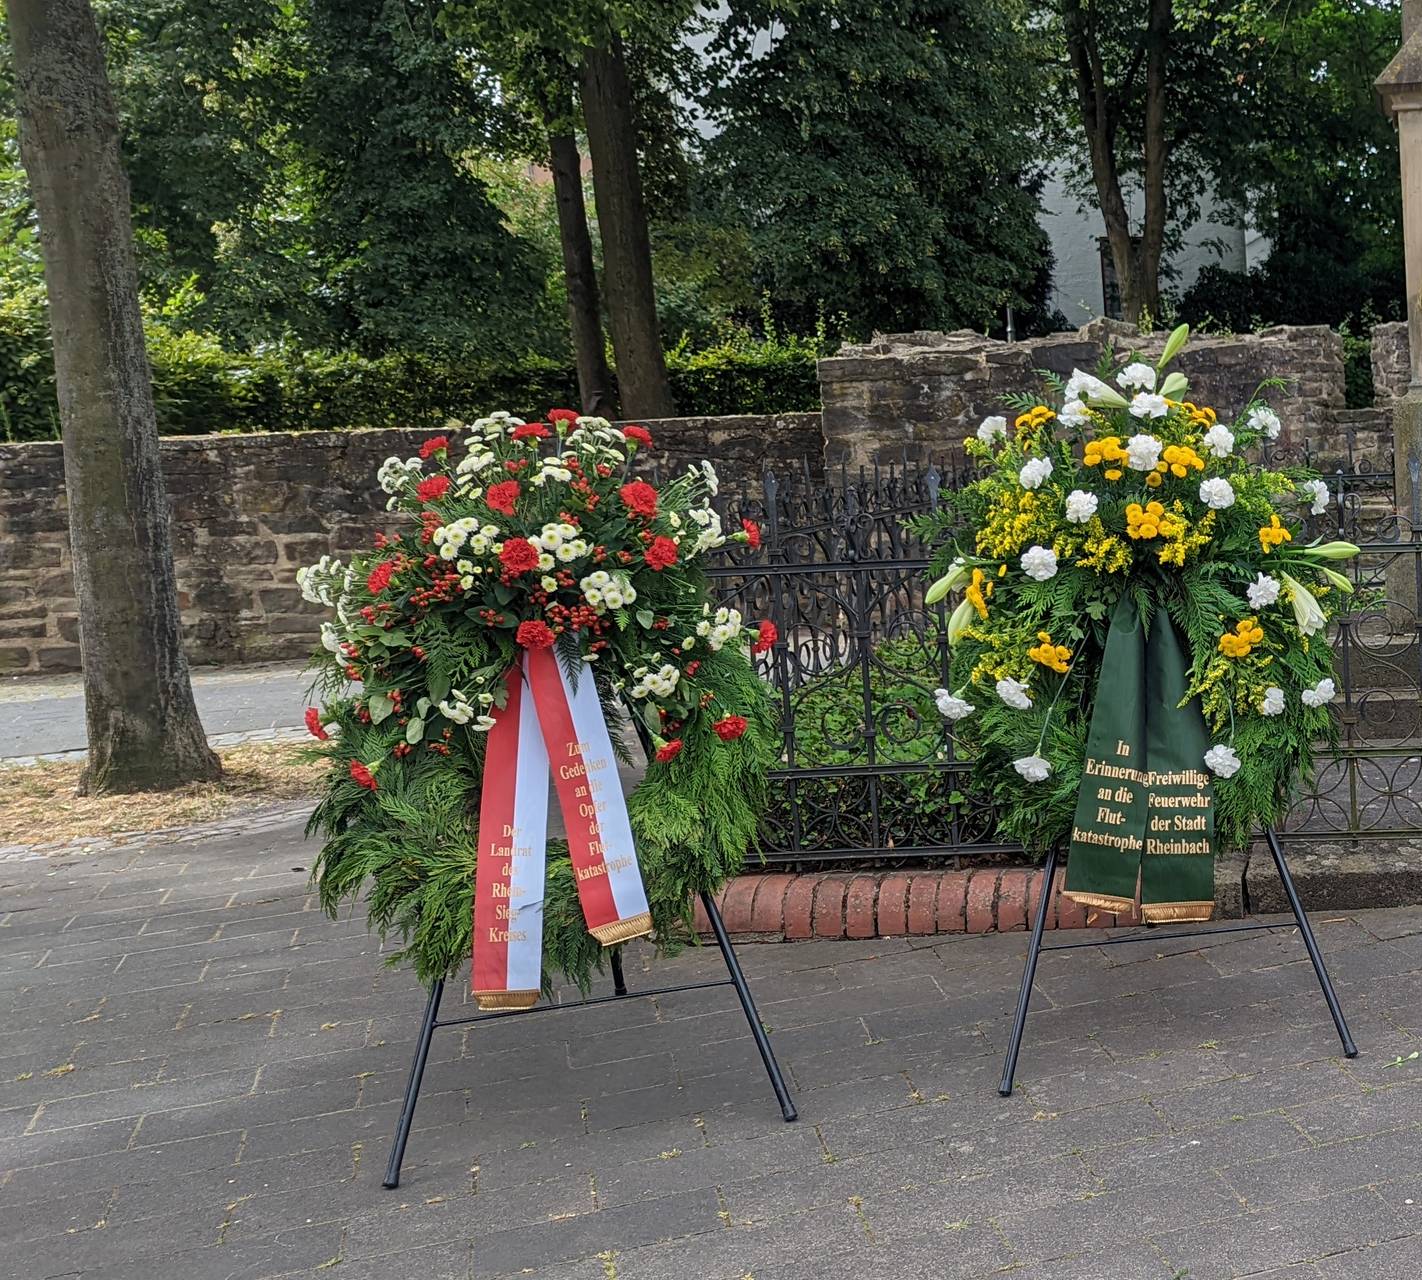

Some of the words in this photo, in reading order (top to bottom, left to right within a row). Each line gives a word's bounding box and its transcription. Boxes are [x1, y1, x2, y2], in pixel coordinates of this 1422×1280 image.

[567, 742, 591, 757] Zum
[1116, 740, 1130, 756] In
[560, 758, 608, 780] Gedenken
[1085, 758, 1149, 788] Erinnerung
[1147, 769, 1209, 790] Freiwillige
[575, 785, 587, 798] an
[589, 779, 603, 796] die
[1097, 787, 1112, 801] an
[1115, 786, 1133, 804] die
[1148, 792, 1211, 808] Feuerwehr
[579, 801, 607, 818] Opfer
[1096, 806, 1126, 825] Flut-
[503, 824, 522, 838] Der
[589, 821, 604, 836] der
[1150, 815, 1171, 831] der
[1174, 815, 1207, 831] Stadt
[1072, 826, 1143, 853] katastrophe
[1146, 838, 1210, 855] Rheinbach
[490, 843, 533, 857] Landrat
[577, 855, 633, 881] katastrophe
[488, 927, 528, 943] Kreises
